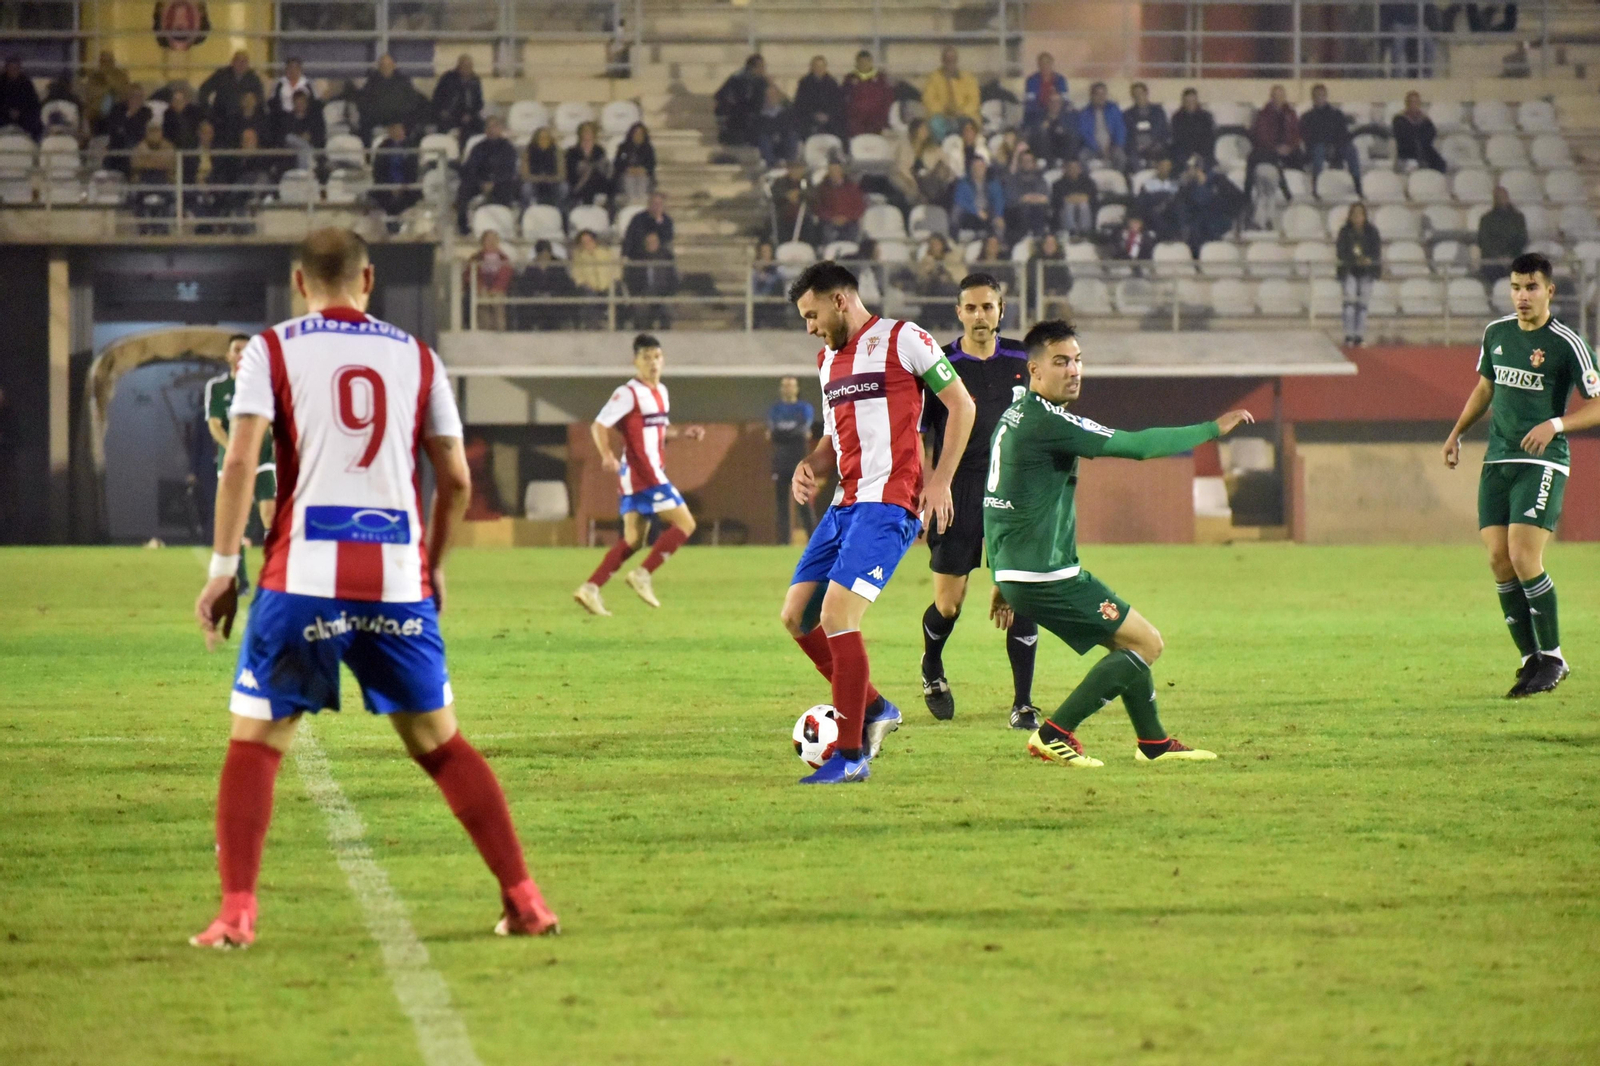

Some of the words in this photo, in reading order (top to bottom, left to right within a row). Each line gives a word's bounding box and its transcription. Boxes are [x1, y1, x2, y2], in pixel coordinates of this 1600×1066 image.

[303, 319, 409, 341] STOP-FLUID
[936, 362, 952, 381] C
[331, 365, 387, 473] 9
